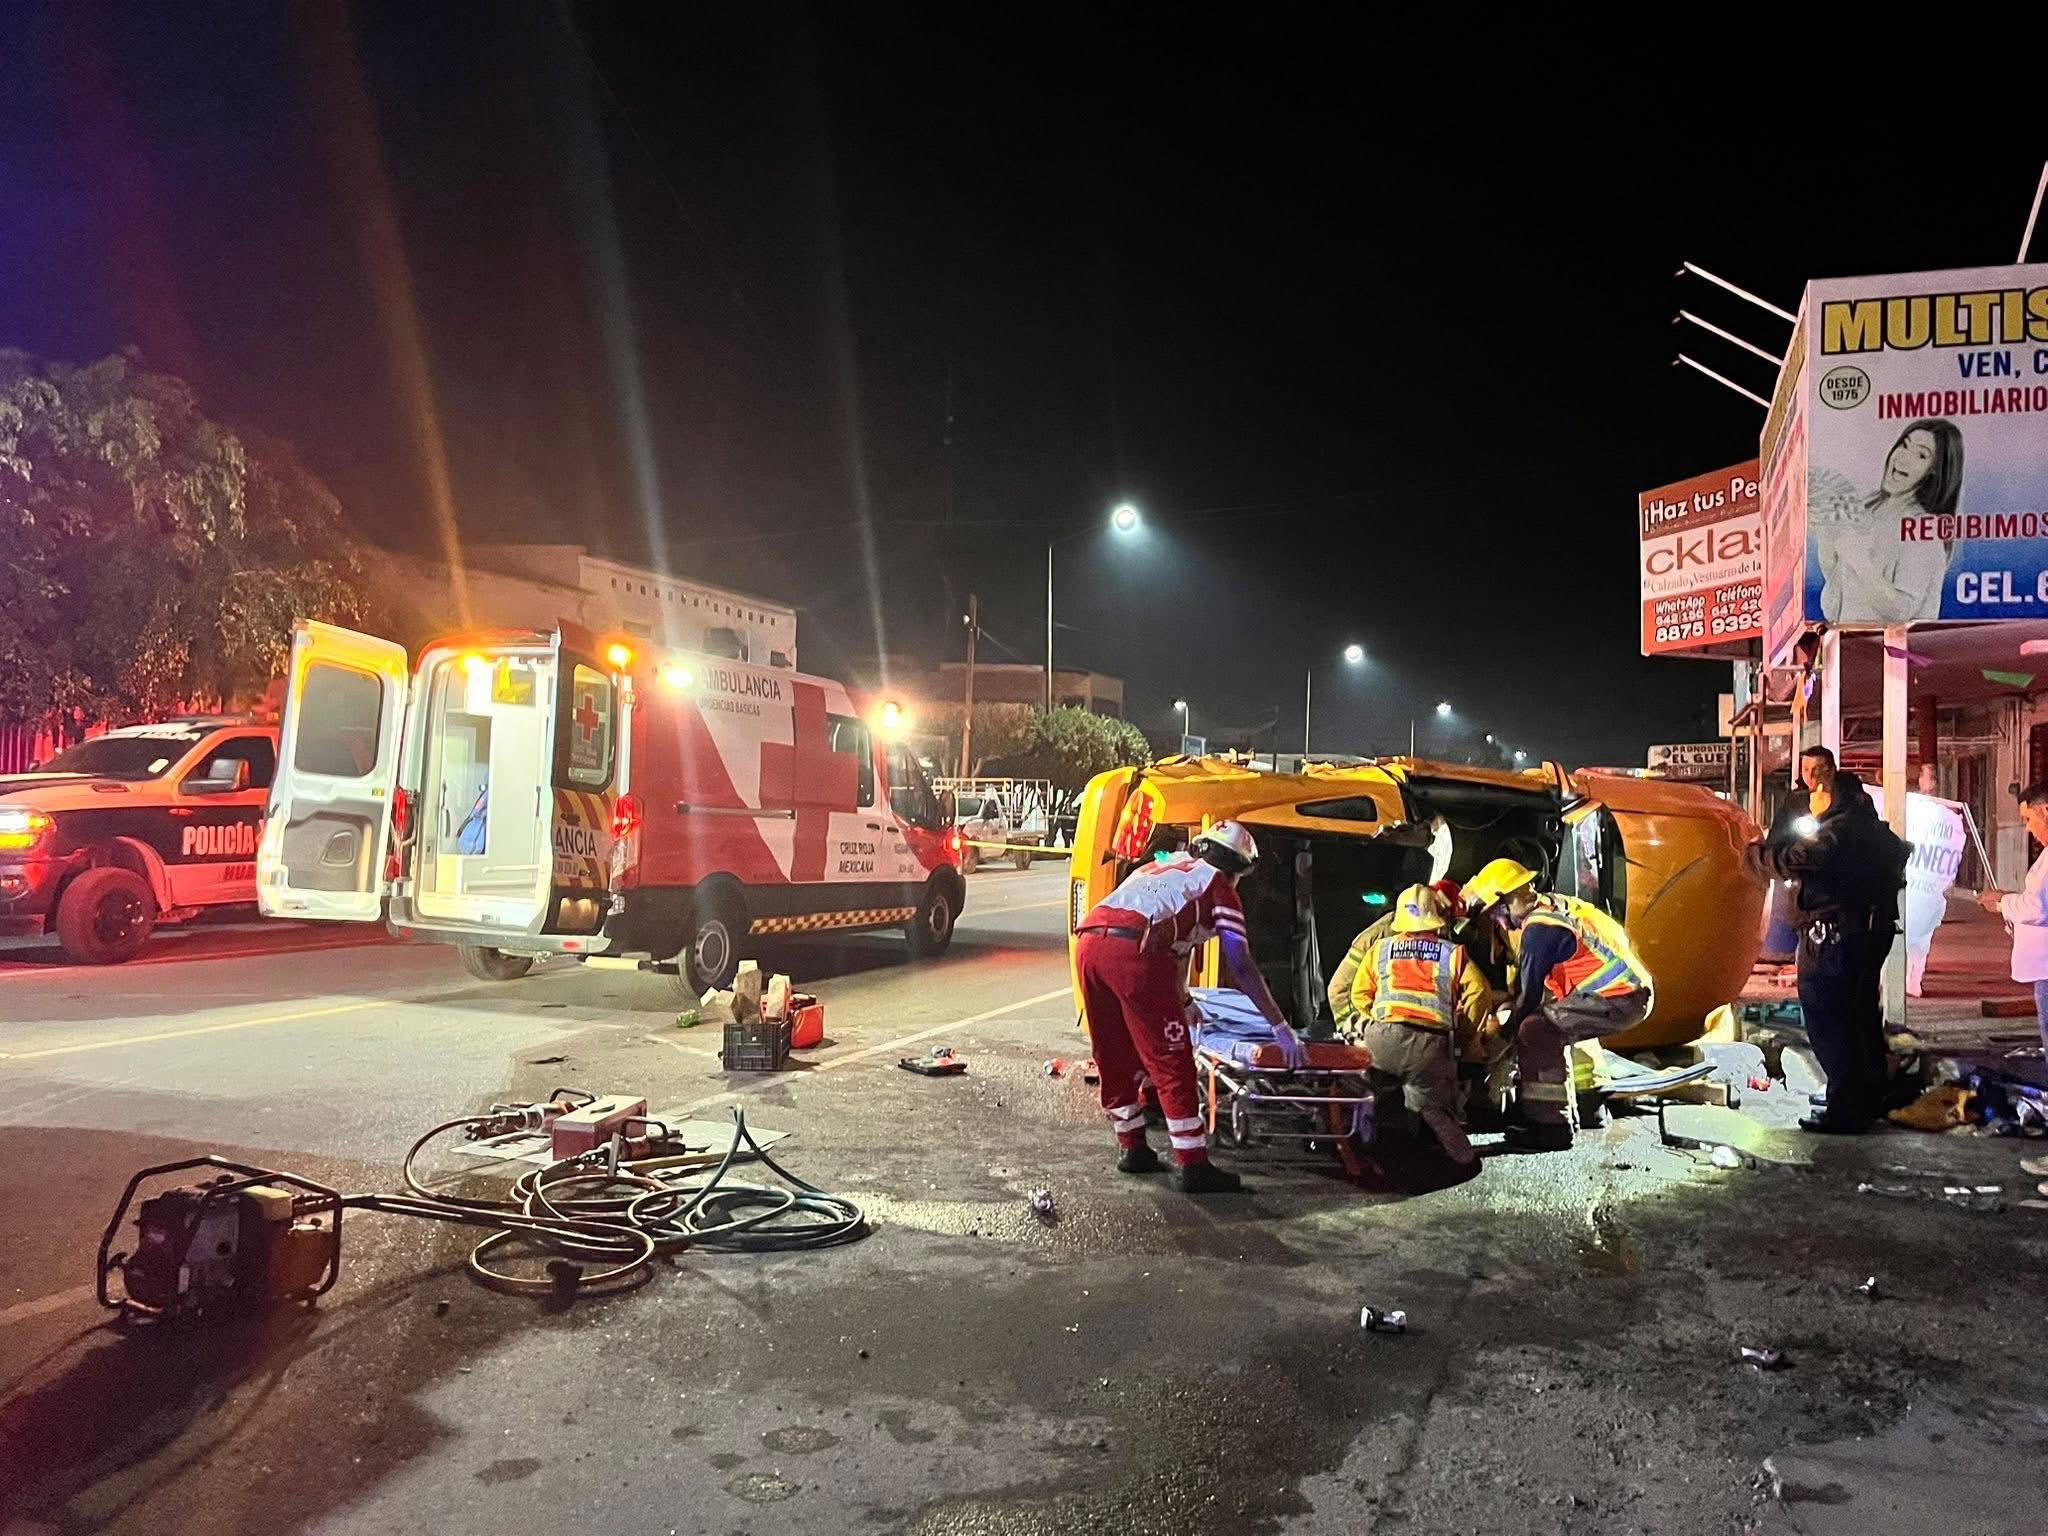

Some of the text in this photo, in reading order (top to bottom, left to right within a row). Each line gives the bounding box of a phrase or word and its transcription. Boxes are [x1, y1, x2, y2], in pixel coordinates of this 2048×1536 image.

[1958, 350, 2021, 378] VEN,
[1826, 376, 1864, 390] DESDE
[1878, 386, 2048, 419] INMOBILIARIO
[1644, 499, 1689, 533] ¡Haz
[1694, 490, 1725, 513] tus
[1730, 477, 1761, 503] Pe
[1646, 527, 1761, 575] ckla
[1738, 562, 1751, 575] de
[1655, 595, 1706, 615] WhatsApp
[1740, 598, 1761, 611] 42
[1672, 754, 1688, 764] EL
[183, 821, 255, 856] POLICÍA
[840, 842, 875, 855] CRUZ ROJA
[839, 861, 874, 873] MEXICANA
[1393, 940, 1440, 952] BOMBEROS
